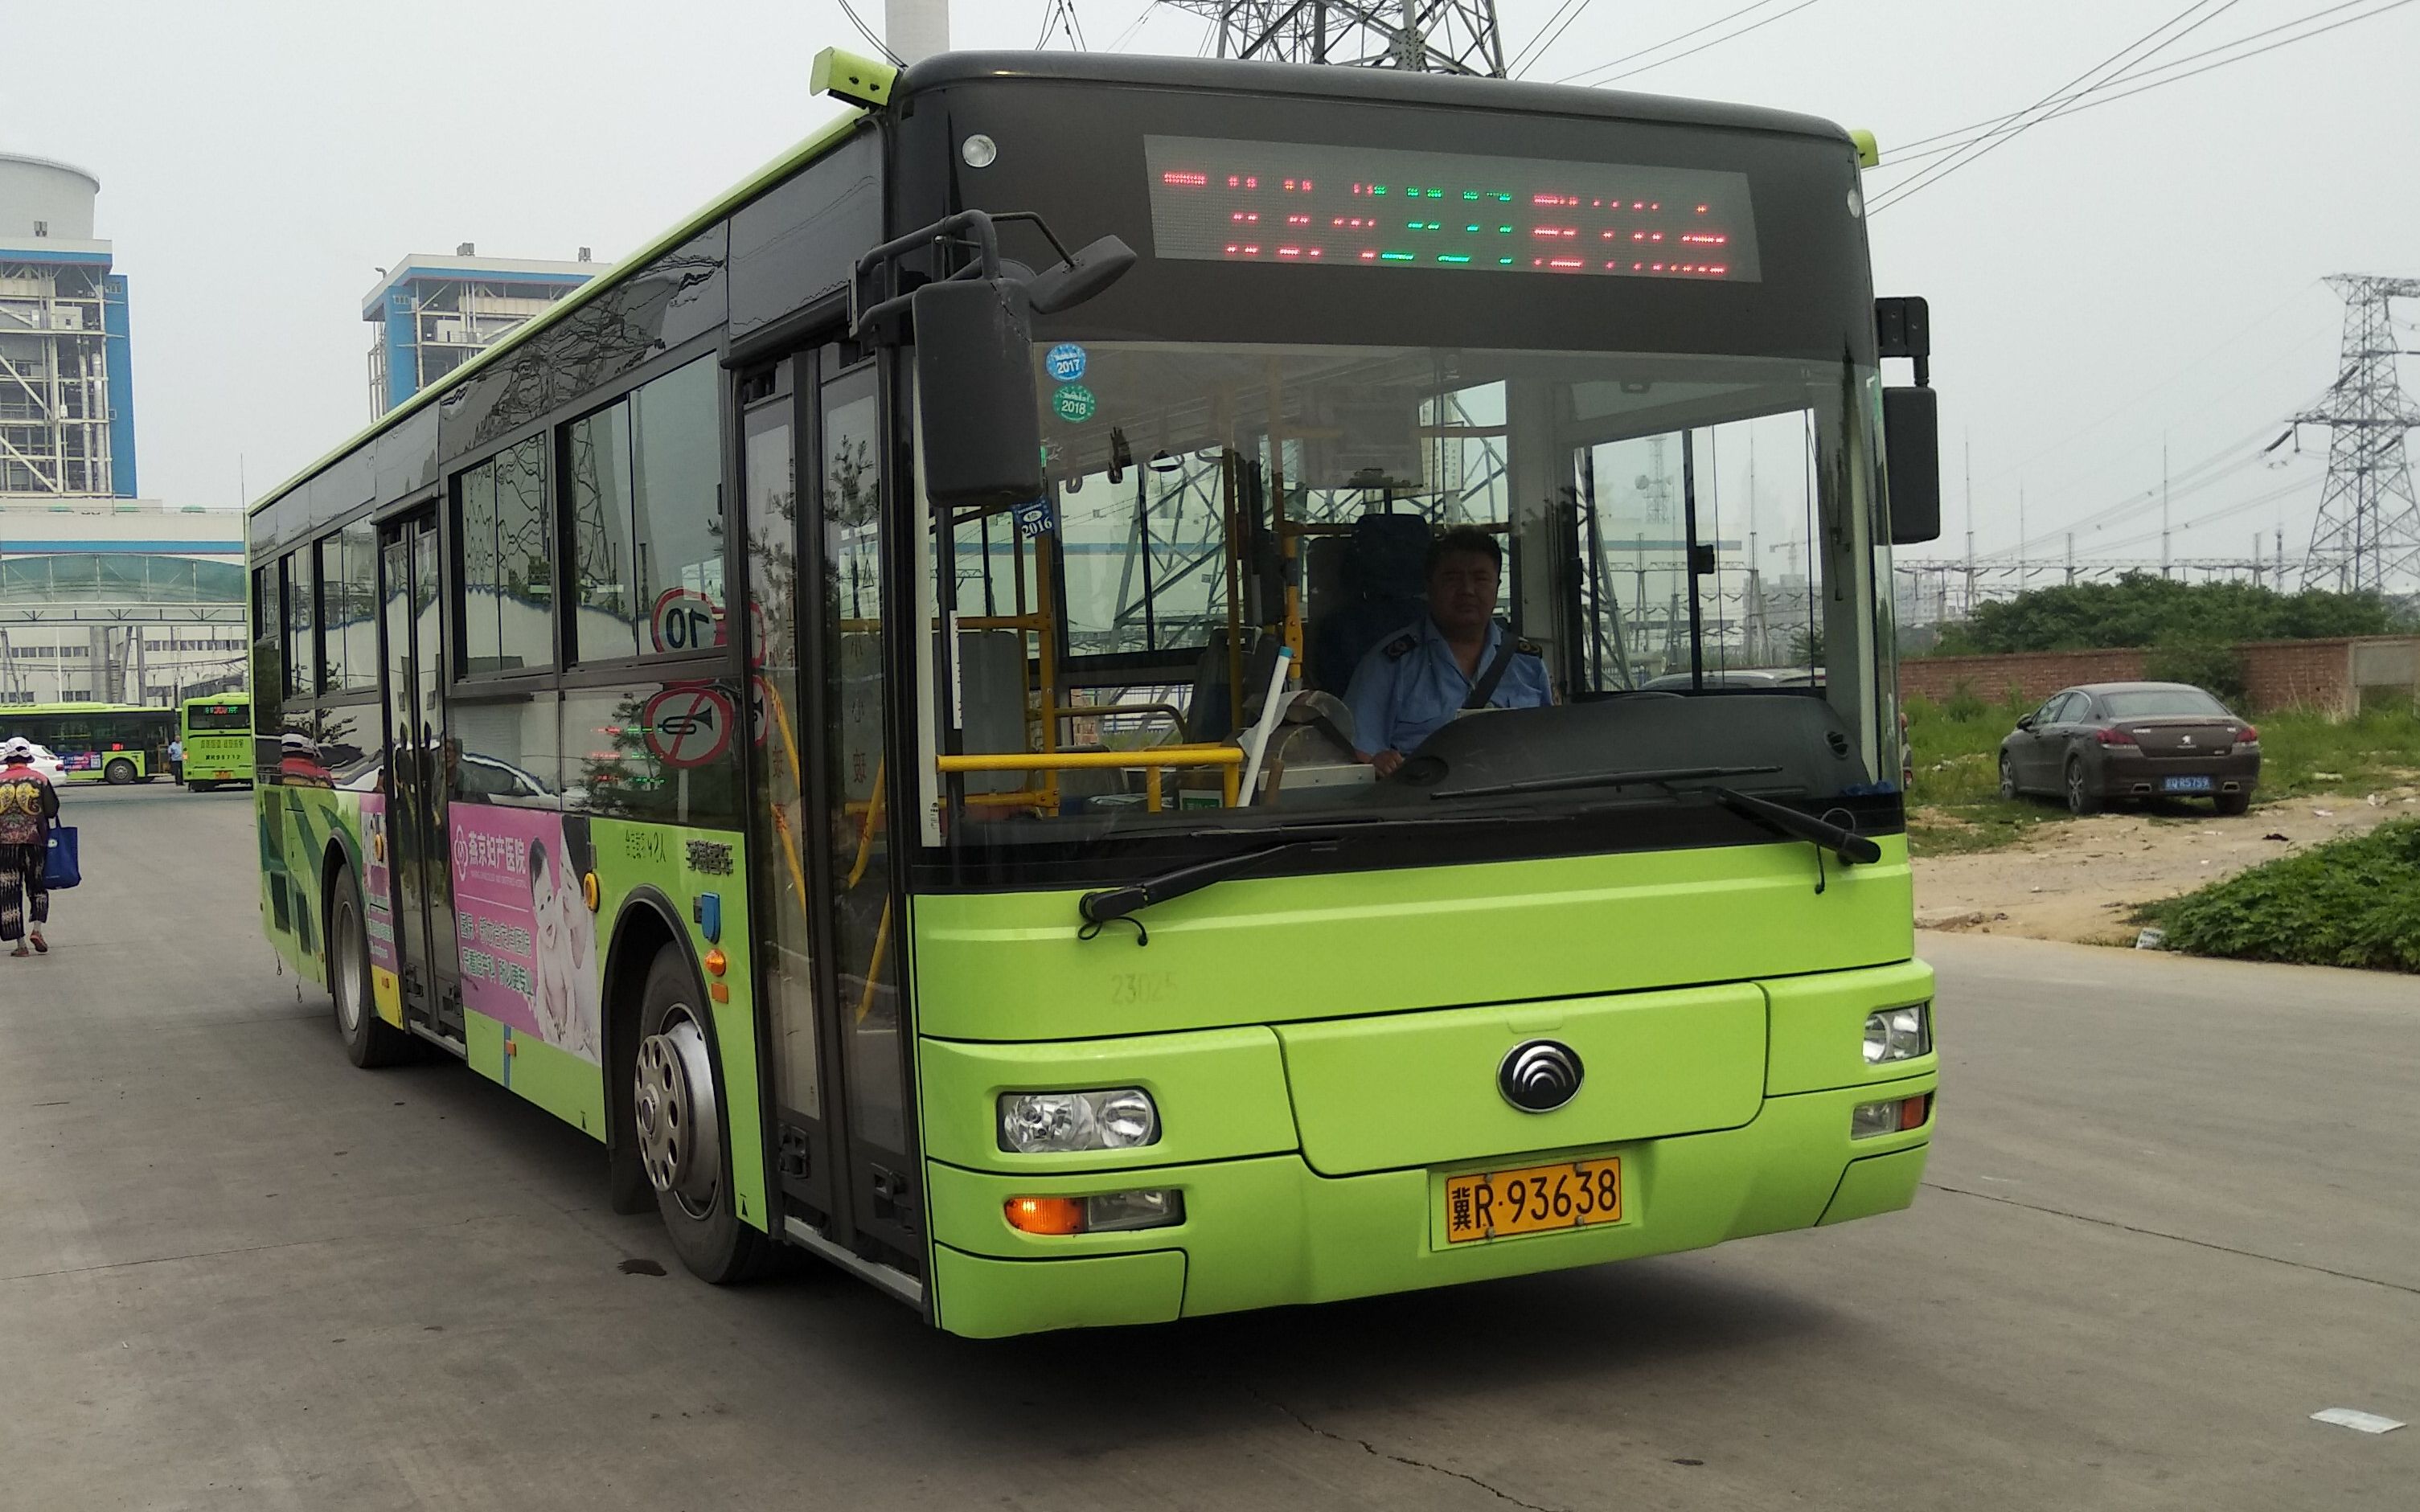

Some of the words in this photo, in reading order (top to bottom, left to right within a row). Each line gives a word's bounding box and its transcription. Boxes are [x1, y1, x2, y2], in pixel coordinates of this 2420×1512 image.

[1056, 359, 1081, 375] 2017
[1061, 400, 1087, 416] 2018
[1021, 516, 1053, 536] 2016
[468, 830, 527, 875] 燕京妇产医院
